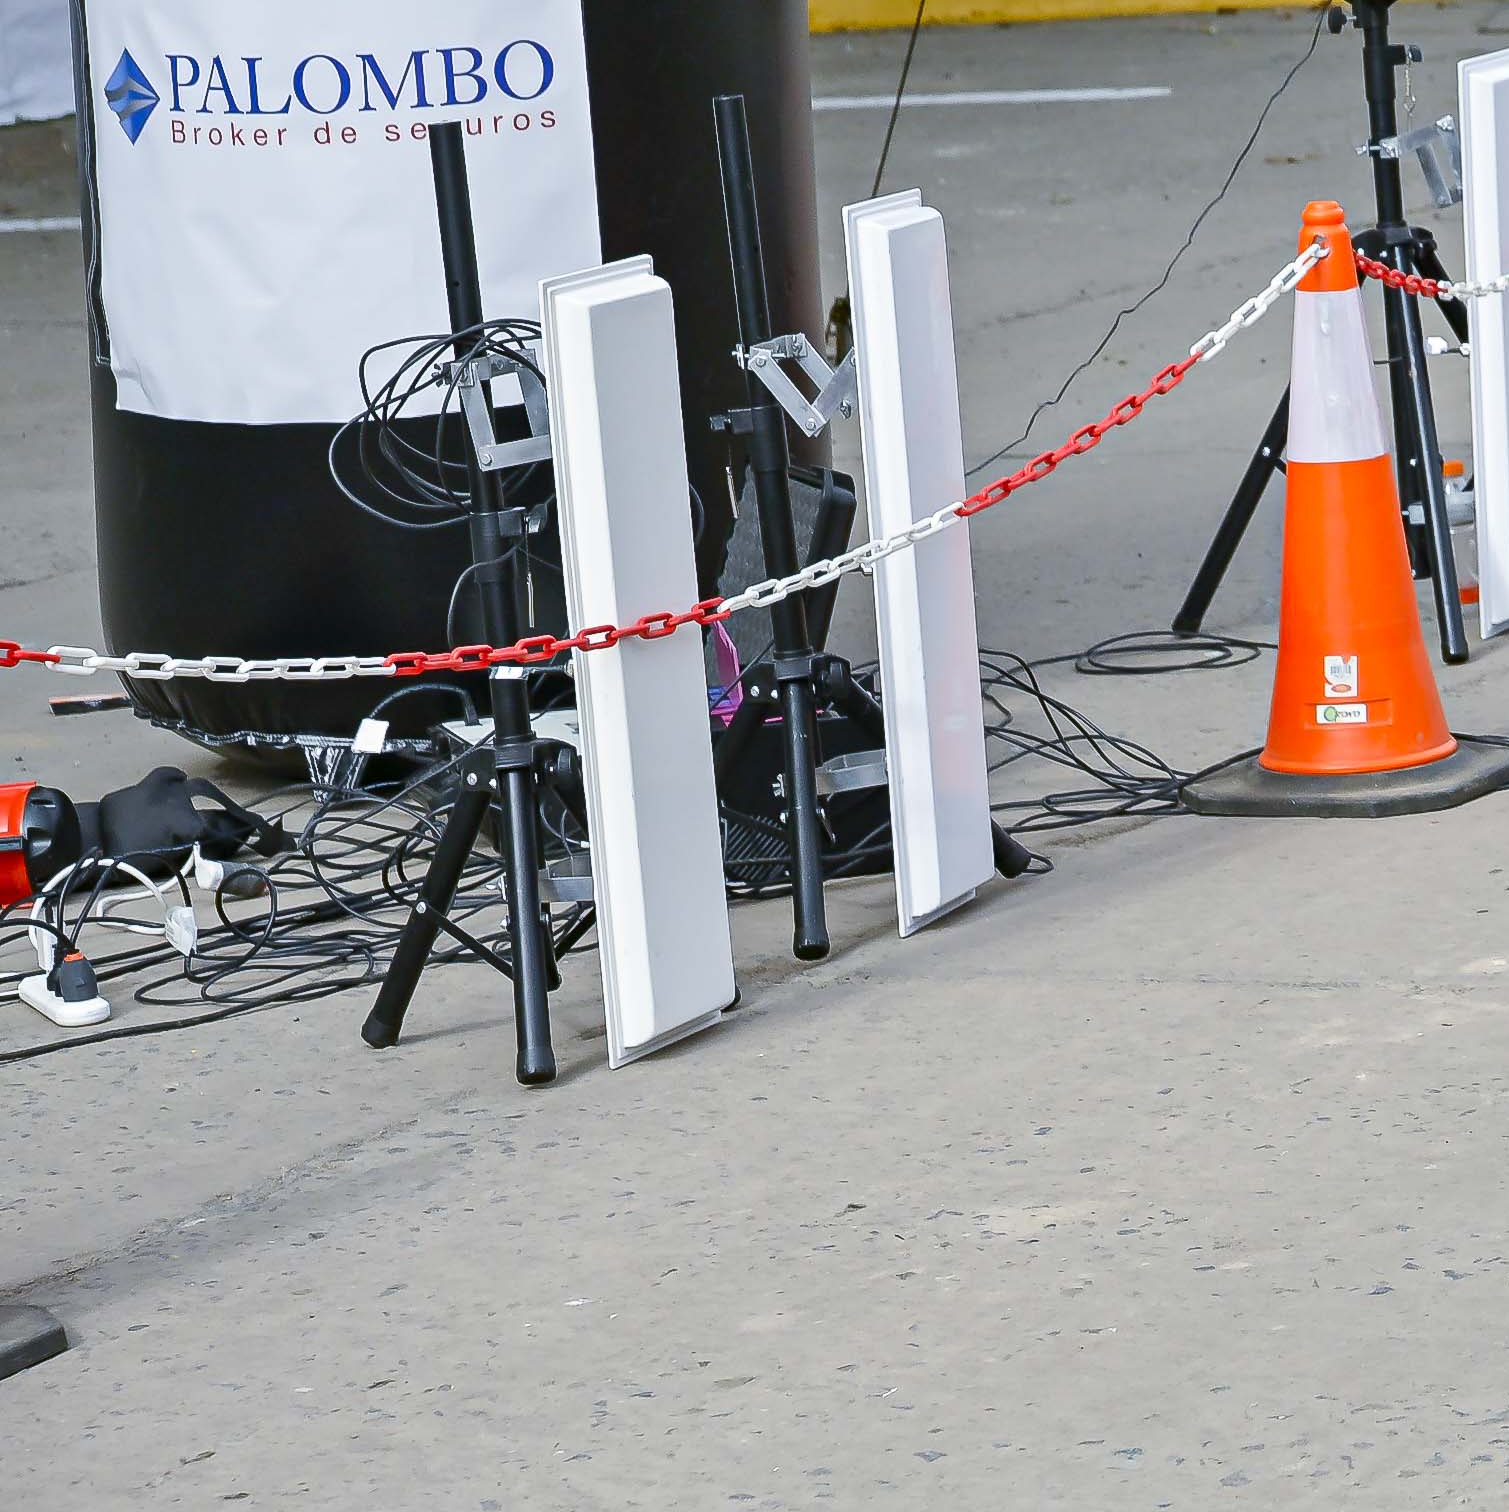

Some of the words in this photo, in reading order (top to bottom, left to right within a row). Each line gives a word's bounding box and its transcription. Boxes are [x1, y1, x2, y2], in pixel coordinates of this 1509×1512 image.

[165, 40, 555, 116] PALOMBO
[172, 122, 287, 145] Broker
[314, 120, 357, 144] de
[385, 108, 557, 143] seuros
